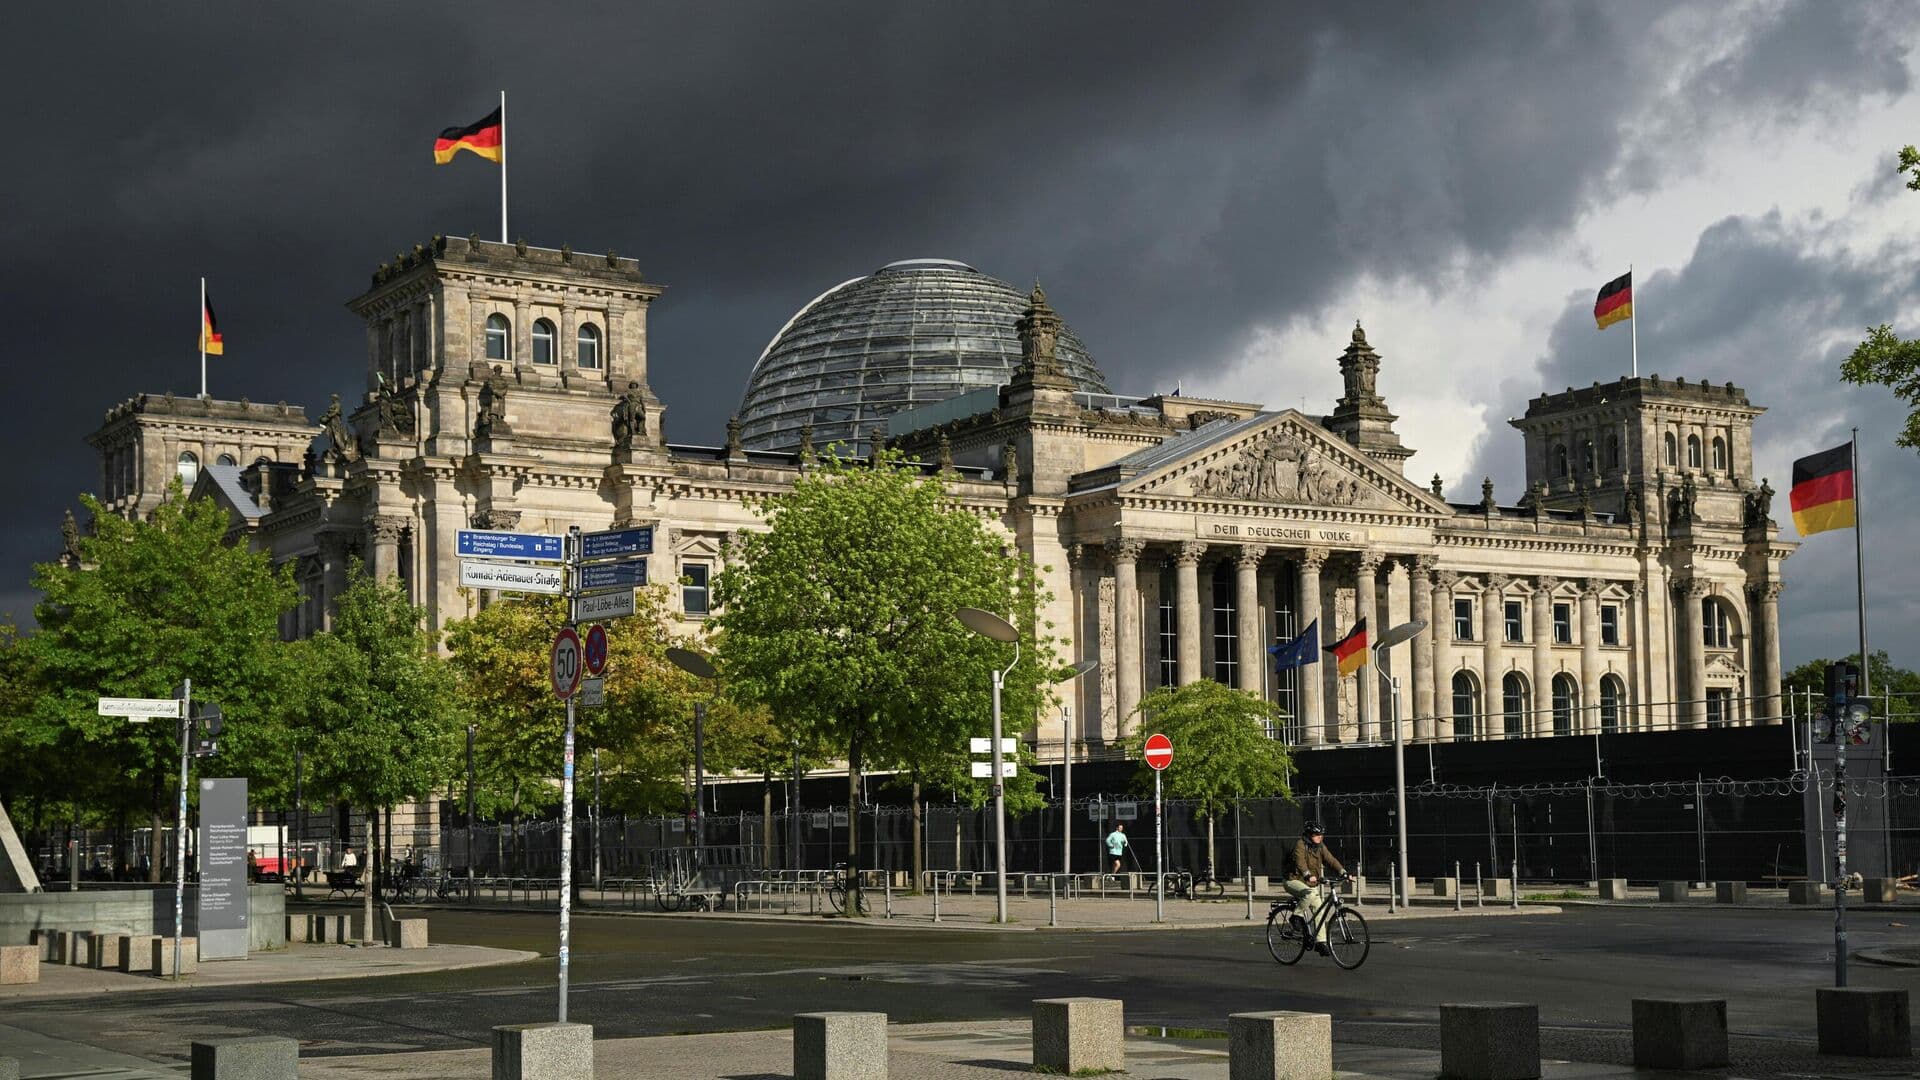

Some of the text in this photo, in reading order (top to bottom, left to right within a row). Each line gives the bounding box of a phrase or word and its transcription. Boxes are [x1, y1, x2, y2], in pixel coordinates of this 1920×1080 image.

[473, 534, 508, 542] Brandenburger
[1214, 524, 1351, 542] DEM DEUTSCHEN VOLKE
[582, 595, 630, 613] Paul-Löbe-Allee
[557, 648, 575, 679] 50
